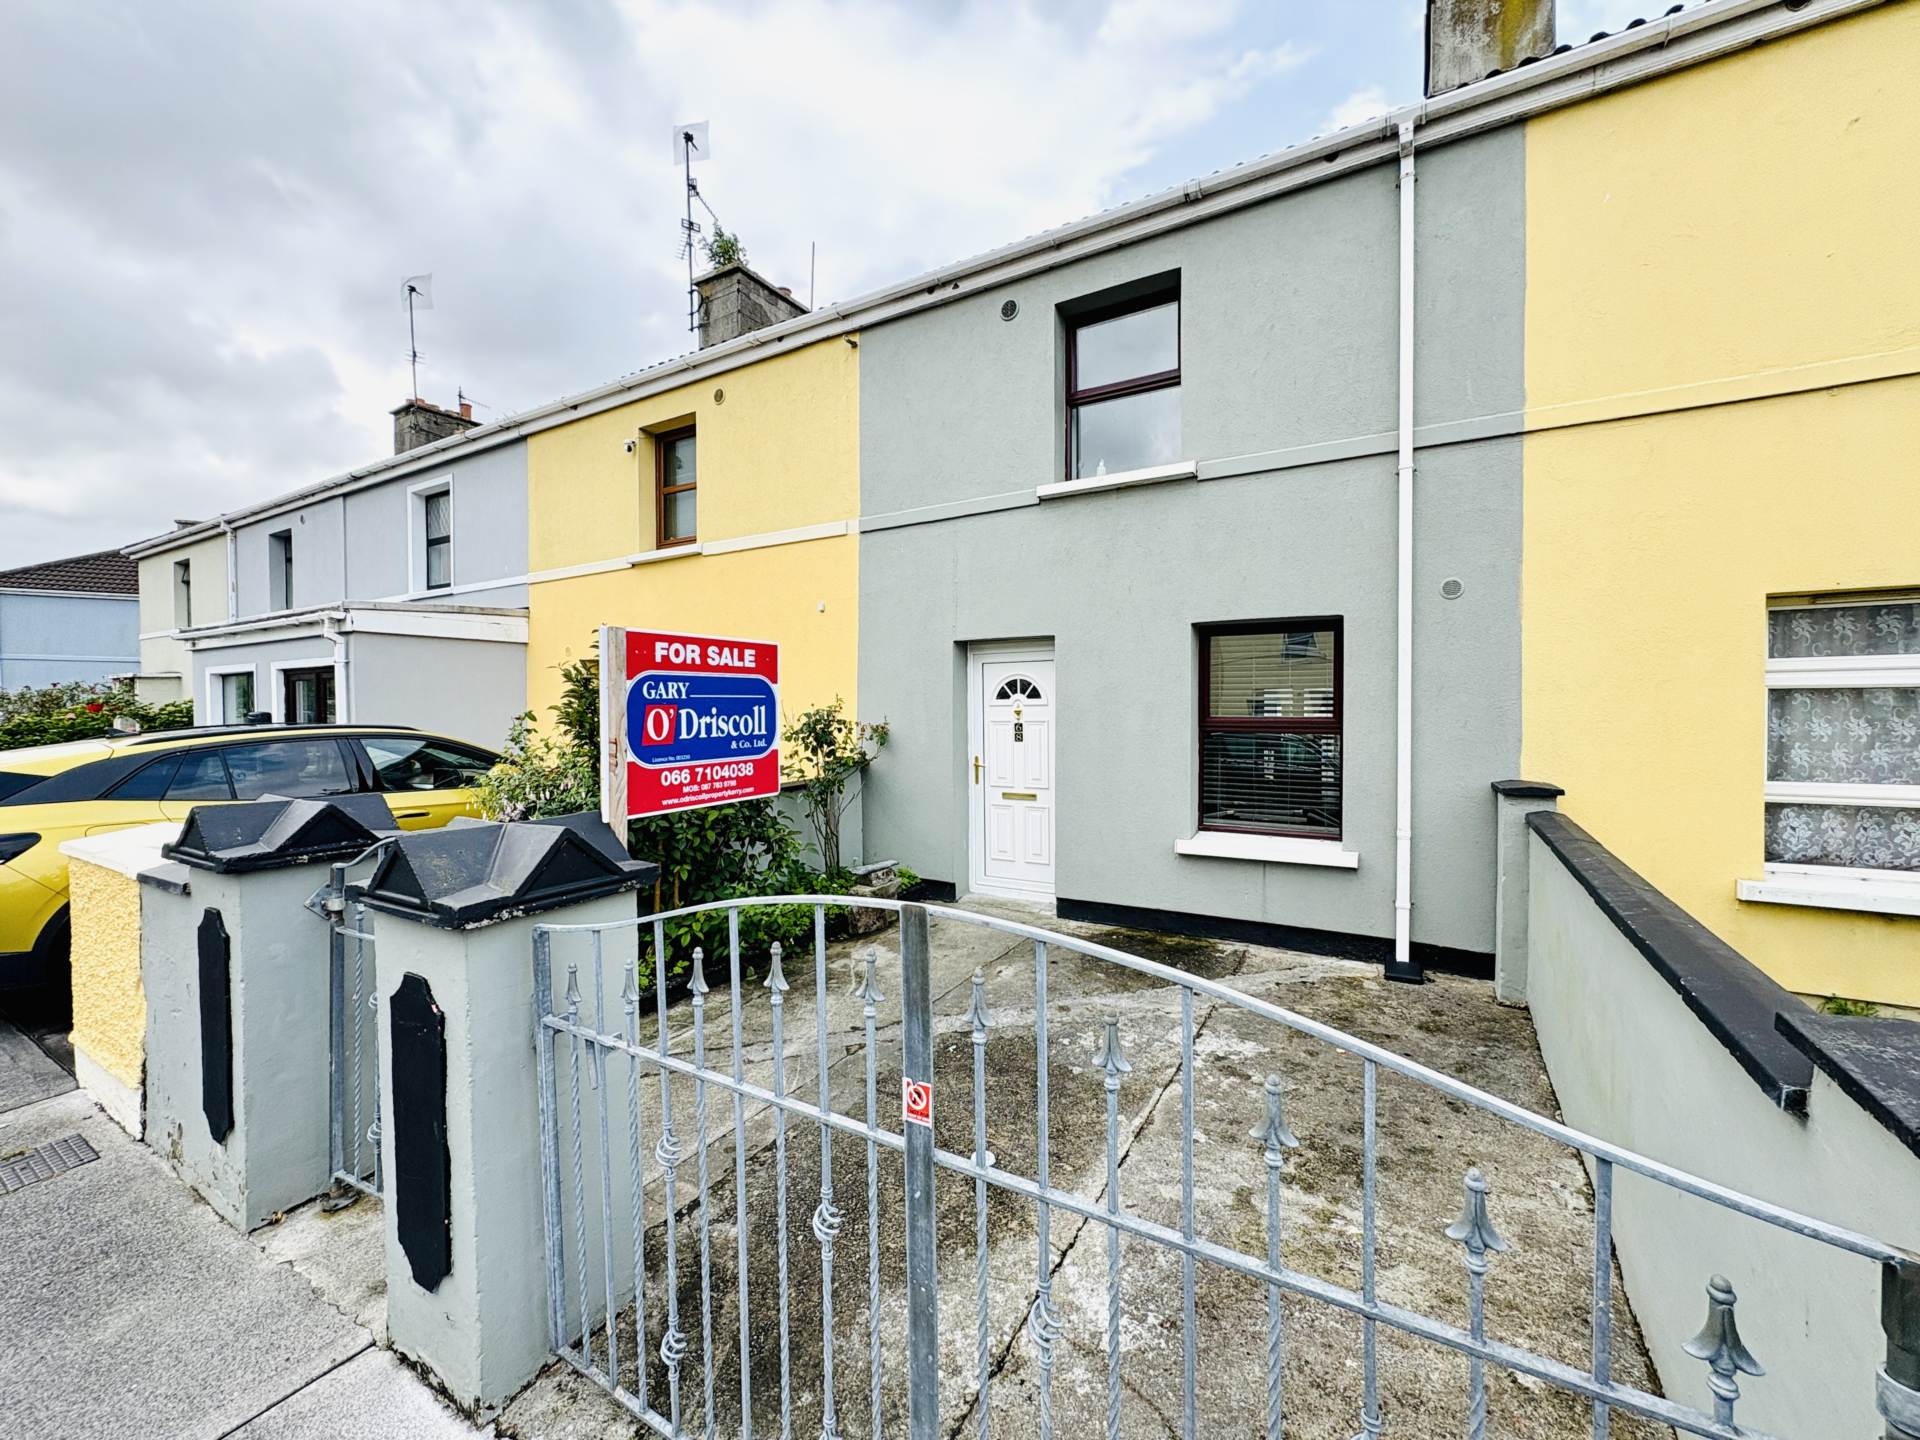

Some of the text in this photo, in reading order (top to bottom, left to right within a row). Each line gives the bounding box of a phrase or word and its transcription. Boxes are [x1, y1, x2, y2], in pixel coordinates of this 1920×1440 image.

[655, 641, 756, 668] FOR SALE
[642, 681, 690, 700] GARY
[646, 705, 767, 741] O'Driscoll
[730, 738, 768, 749] & Co. Ltd.
[660, 762, 754, 786] 066 7104038
